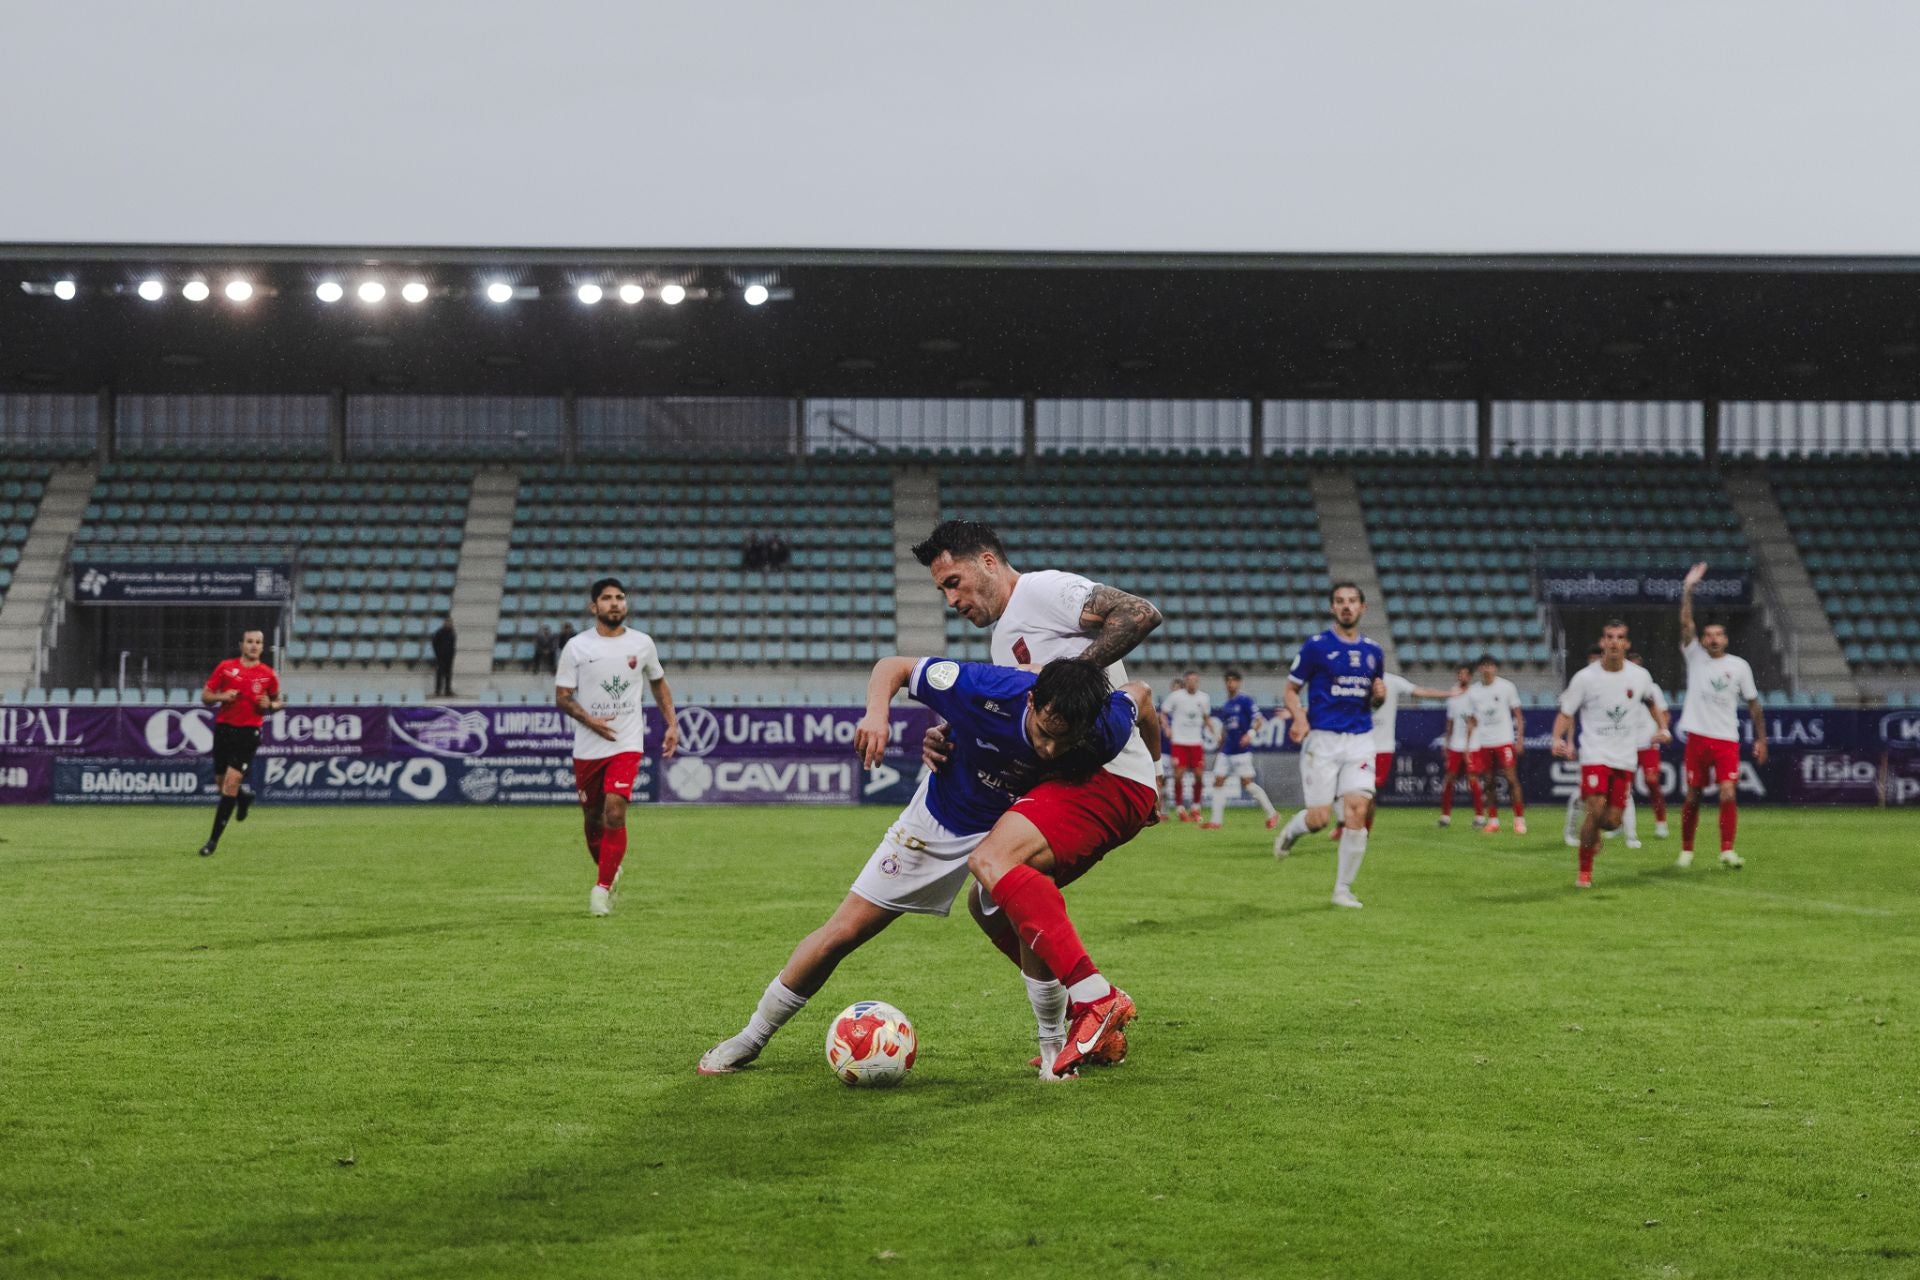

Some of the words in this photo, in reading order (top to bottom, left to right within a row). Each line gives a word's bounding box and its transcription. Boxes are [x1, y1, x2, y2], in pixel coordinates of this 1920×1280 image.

[271, 710, 362, 742] tega
[494, 712, 562, 735] LIMPIEZA
[724, 713, 795, 744] Ural
[804, 713, 908, 744] Mor
[81, 768, 198, 793] BAÑOSALUD
[264, 755, 325, 787] Bar
[715, 762, 851, 792] CAVITI
[1802, 754, 1876, 783] fisio
